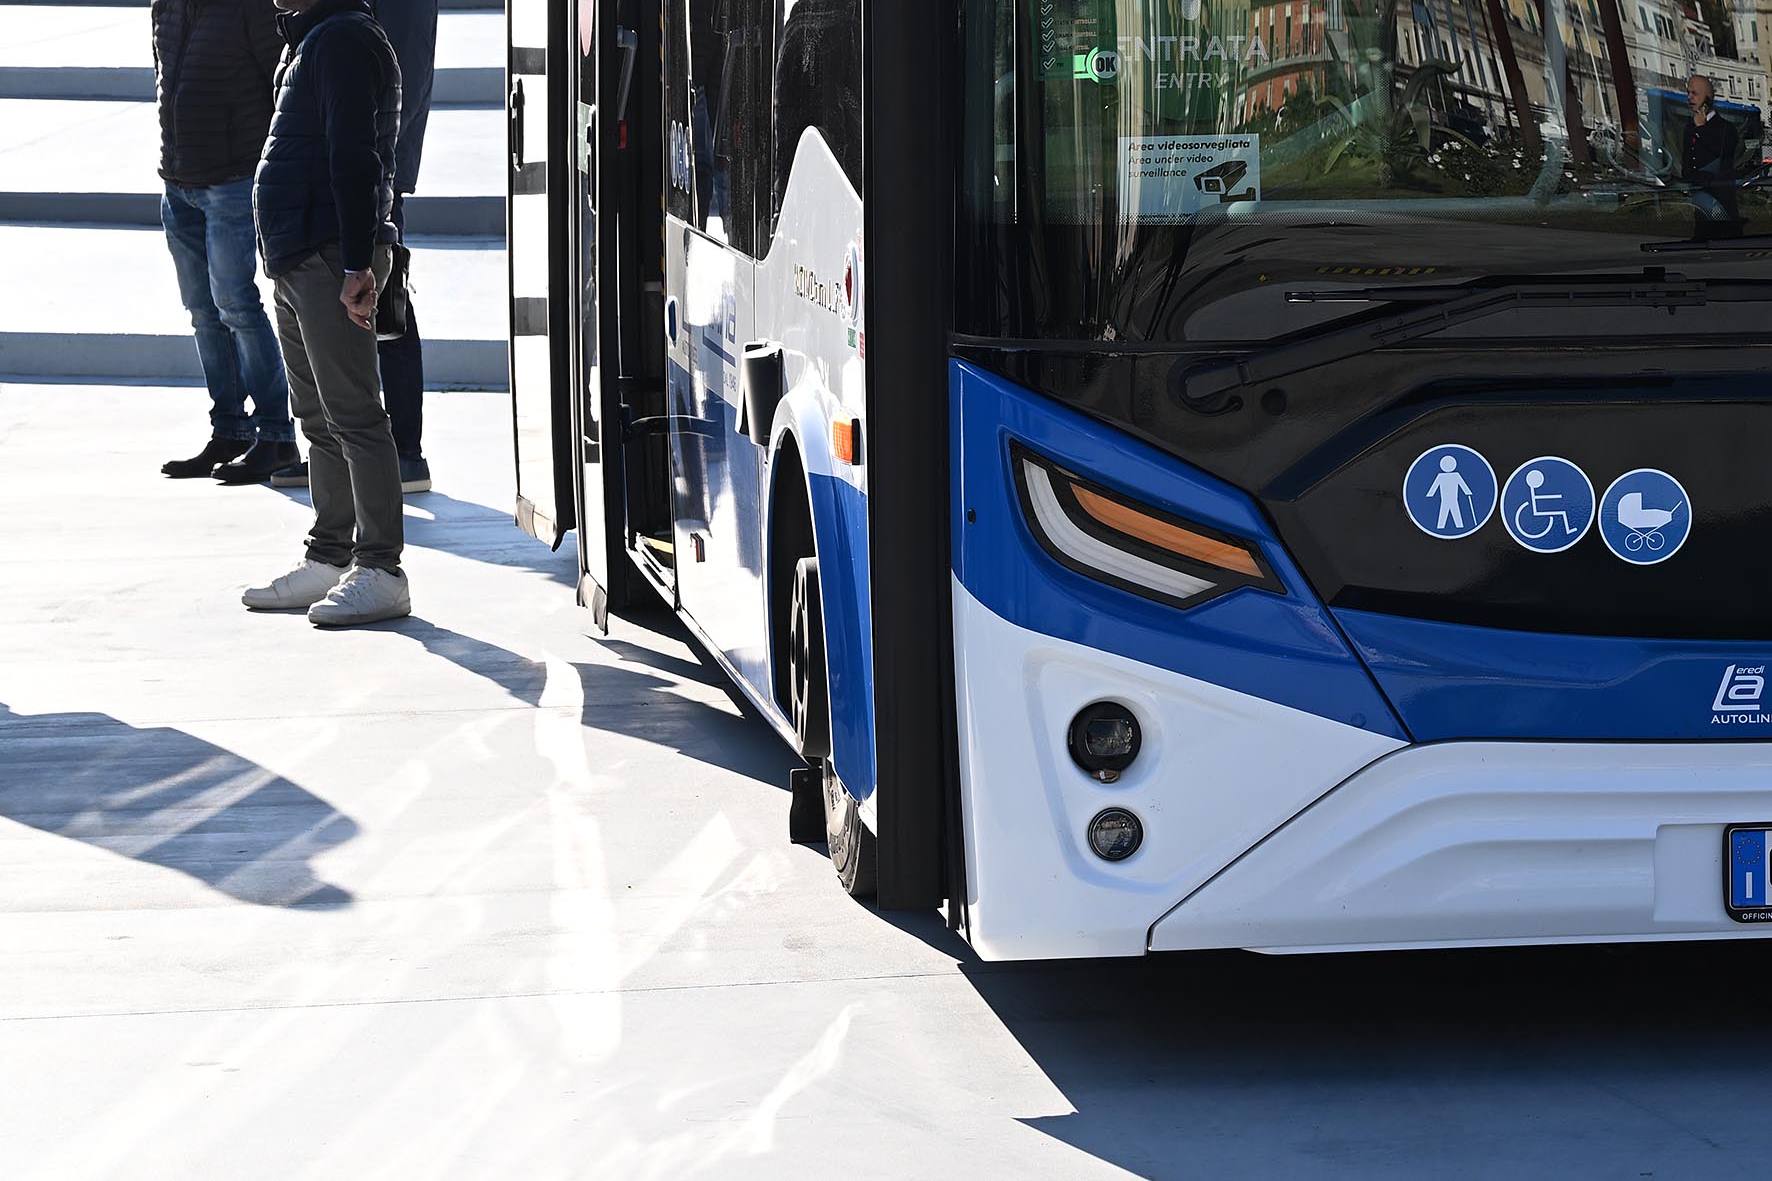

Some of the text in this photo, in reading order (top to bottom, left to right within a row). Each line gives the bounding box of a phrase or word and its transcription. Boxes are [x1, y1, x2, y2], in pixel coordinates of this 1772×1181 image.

[1117, 35, 1270, 62] ENTRATA
[1095, 57, 1116, 73] OK
[1154, 72, 1230, 89] ENTRY
[1128, 138, 1251, 152] Area videosorvegliata
[1128, 152, 1214, 165] Area under video
[1128, 167, 1187, 179] surveillance
[1735, 664, 1766, 675] eredi
